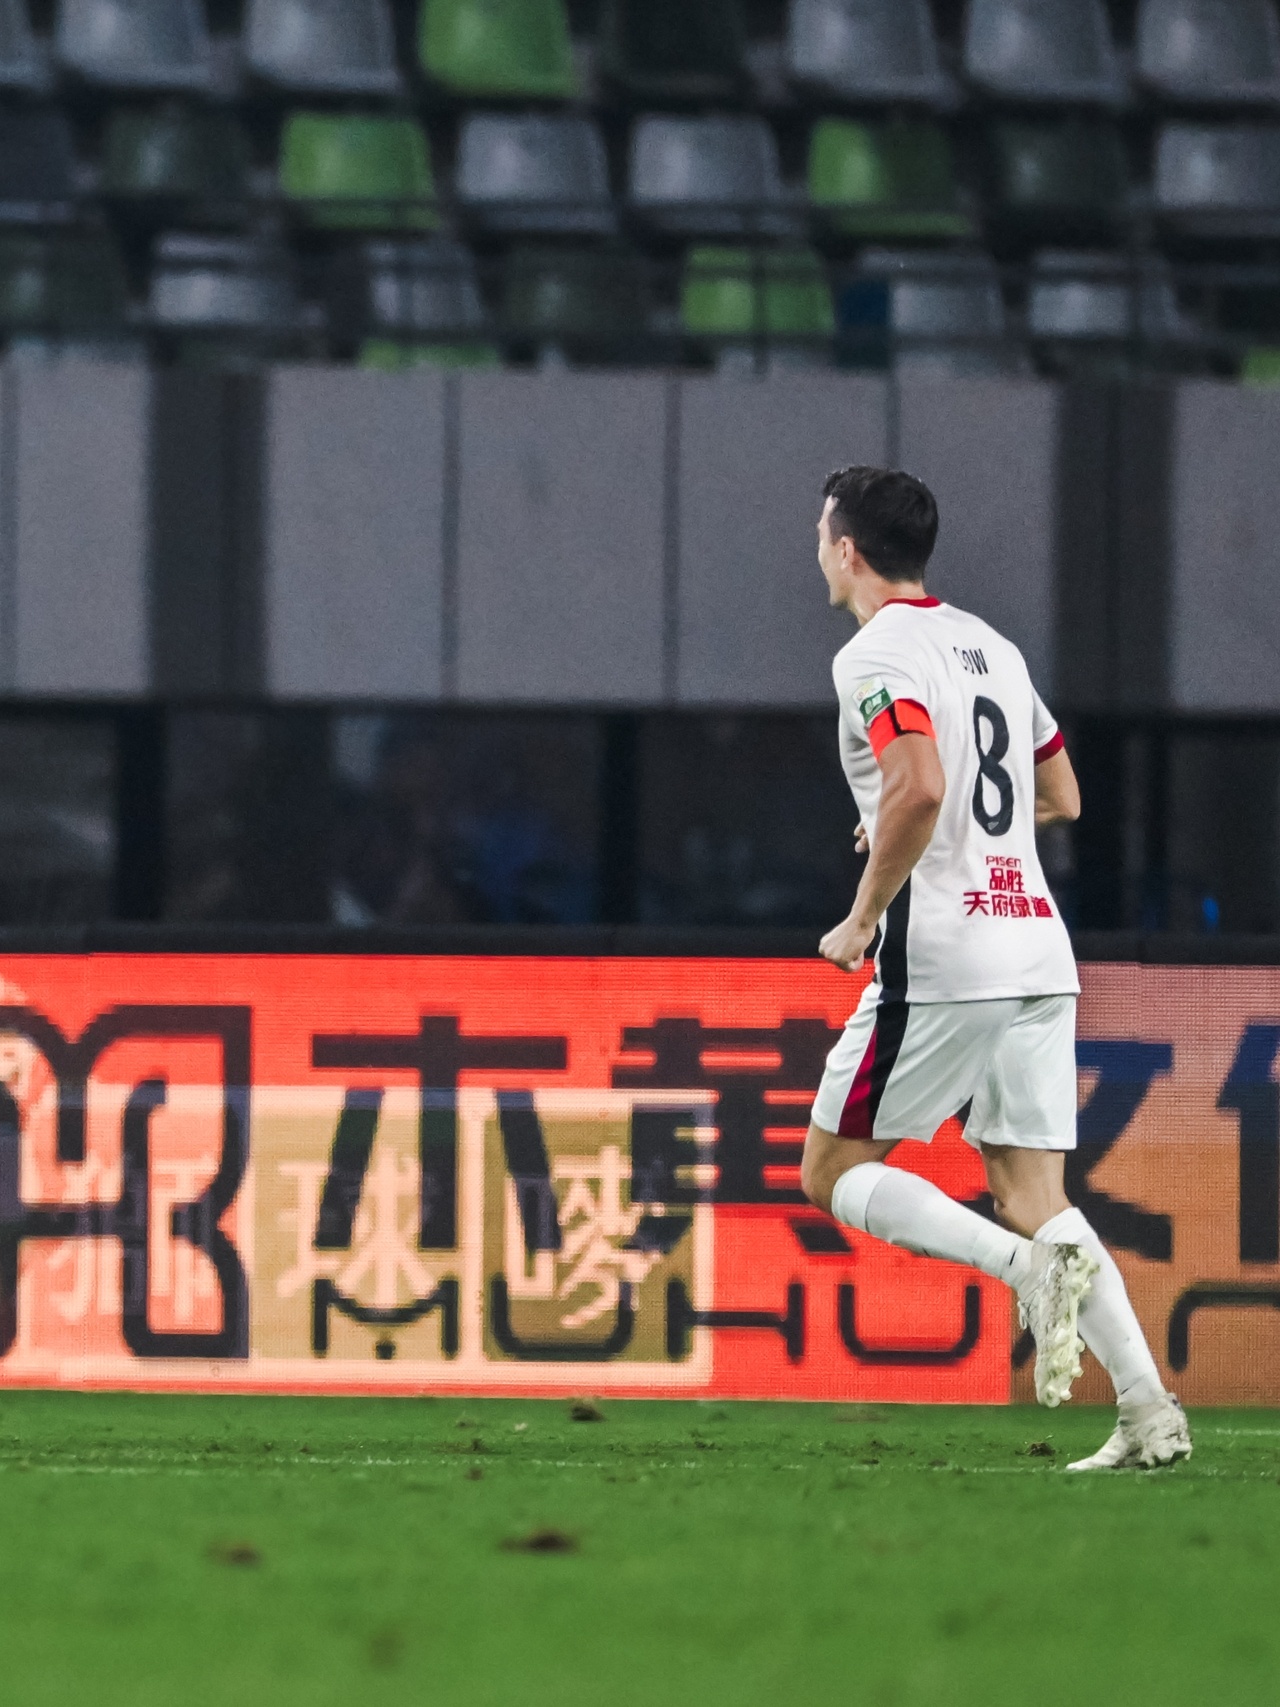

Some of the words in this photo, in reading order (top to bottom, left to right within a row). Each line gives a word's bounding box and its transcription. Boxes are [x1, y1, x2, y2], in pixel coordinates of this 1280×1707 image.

[972, 695, 1014, 837] 8
[989, 867, 1026, 893] 品胜
[963, 891, 1054, 919] 天府绿道
